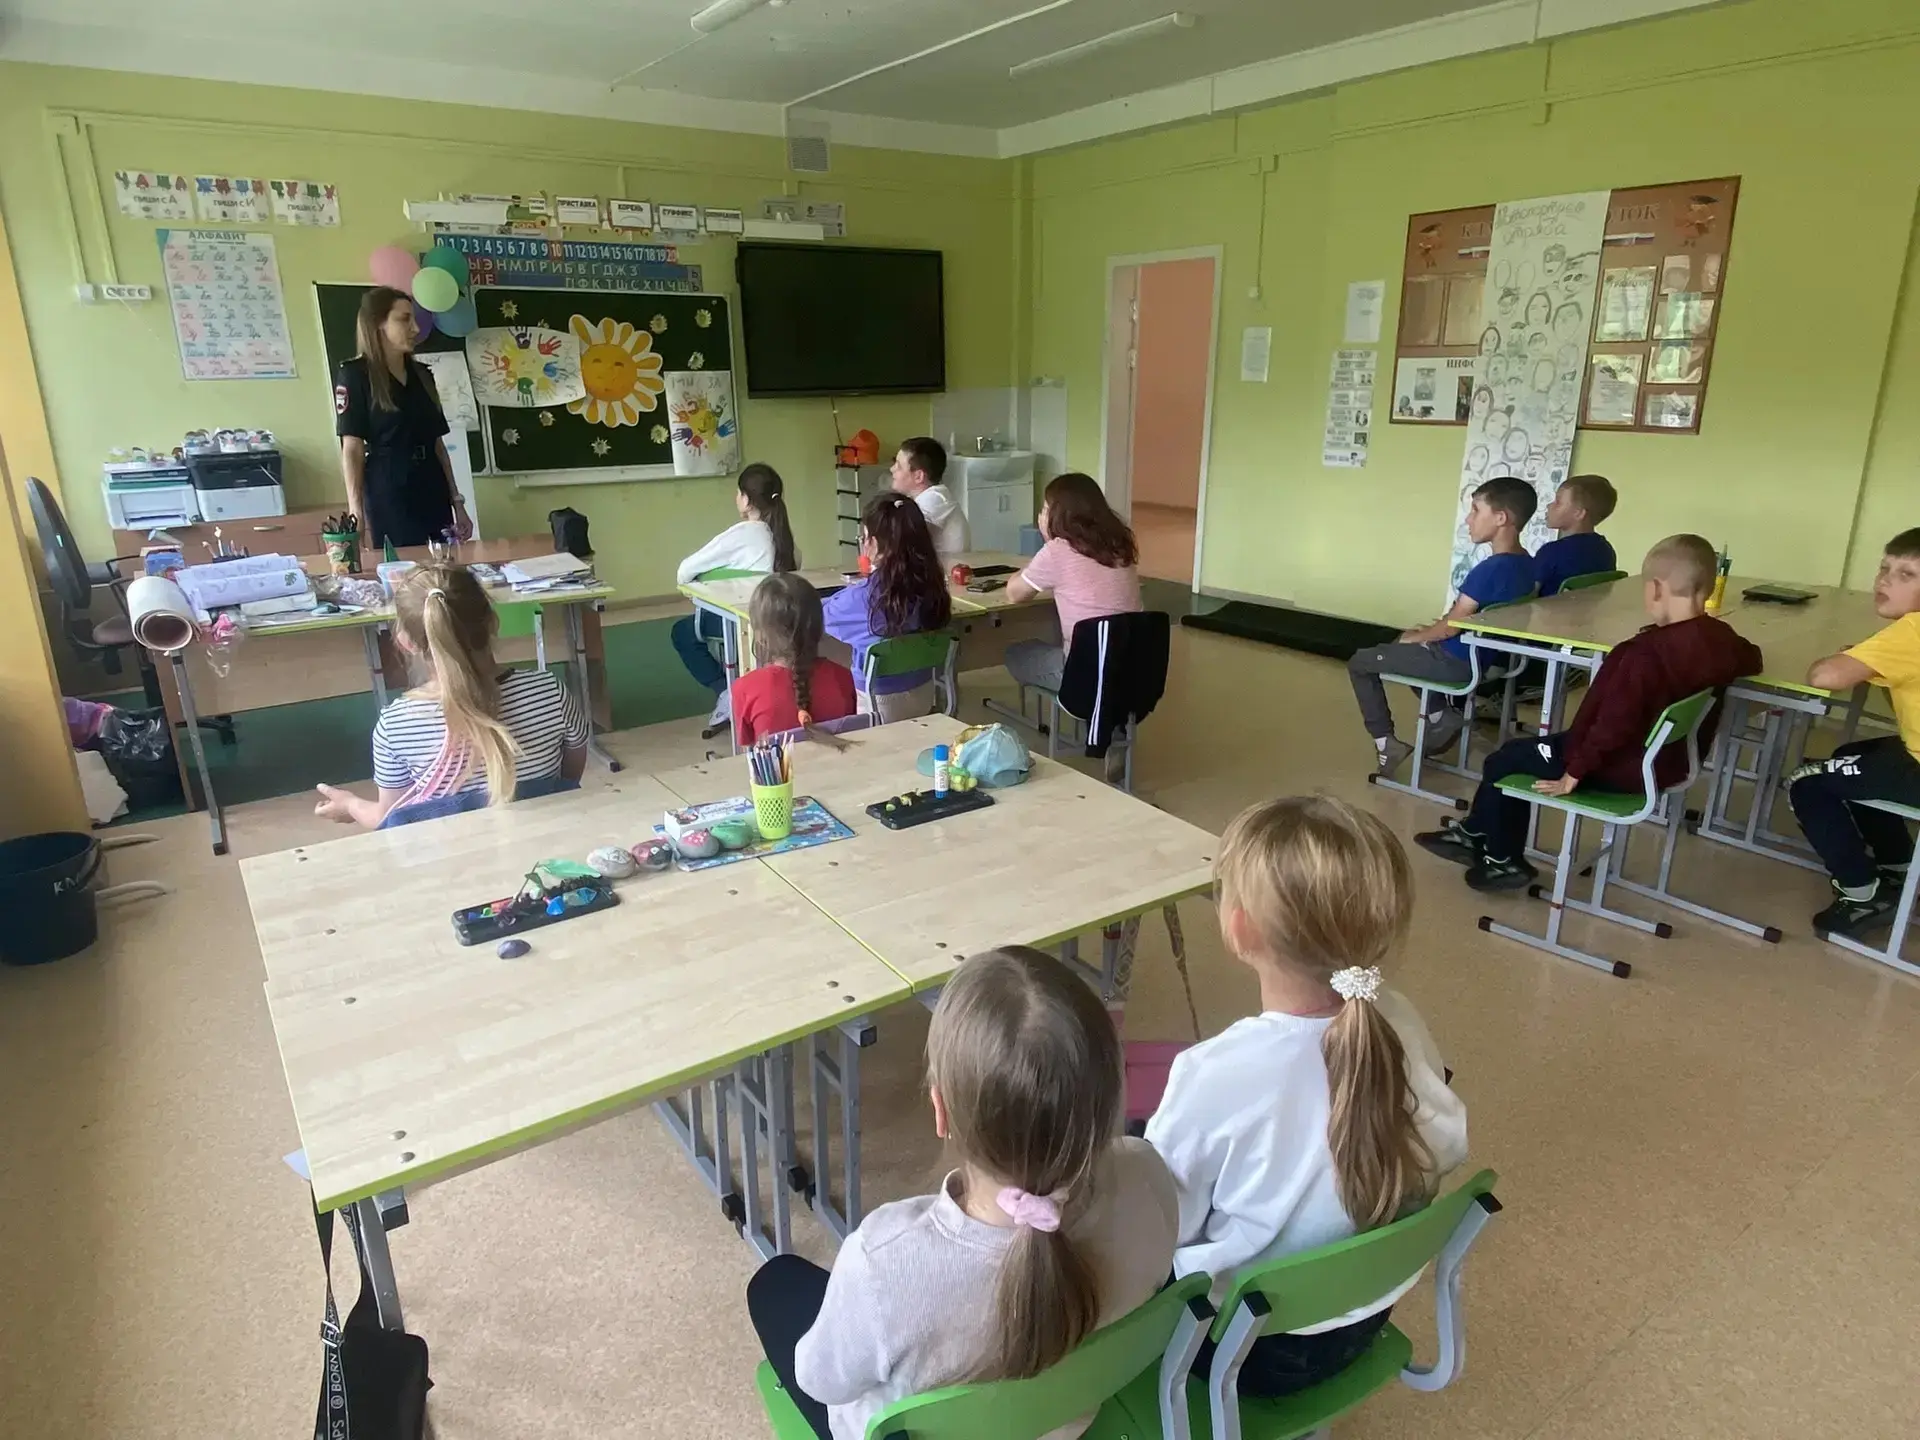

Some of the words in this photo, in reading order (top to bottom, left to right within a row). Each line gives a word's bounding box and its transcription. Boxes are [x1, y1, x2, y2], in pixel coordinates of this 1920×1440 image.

[169, 194, 178, 205] А
[188, 231, 247, 241] АЛФАВИТ
[449, 238, 455, 248] 1
[460, 238, 468, 252] 2
[472, 239, 480, 253] 3
[484, 240, 492, 254] 4
[496, 240, 504, 254] 5
[508, 242, 516, 254] 6
[519, 242, 525, 256] 7
[530, 242, 538, 256] 8
[541, 243, 548, 257] 9
[551, 244, 562, 257] 10
[564, 244, 574, 258] 11
[575, 244, 587, 258] 12
[587, 246, 598, 258] 13
[599, 246, 610, 259] 14
[611, 246, 622, 260] 15
[622, 247, 633, 260] 16
[634, 248, 644, 260] 17
[644, 248, 656, 261] 18
[656, 249, 666, 262] 19
[468, 258, 480, 270] Ы
[483, 258, 492, 270] Э
[496, 260, 507, 270] Н
[510, 260, 522, 272] М
[540, 262, 548, 272] Р
[564, 263, 573, 274] Б
[578, 264, 586, 274] В
[592, 264, 599, 274] Г
[603, 264, 614, 276] Д
[616, 264, 627, 276] Ж
[630, 266, 638, 277] З
[486, 274, 495, 286] Е
[566, 278, 575, 288] П
[578, 278, 587, 288] Ф
[592, 279, 600, 290] К
[606, 280, 614, 290] Т
[616, 280, 628, 290] Ш
[631, 280, 638, 290] С
[643, 280, 651, 290] Х
[654, 280, 664, 291] Ц
[329, 1352, 343, 1392] BORN
